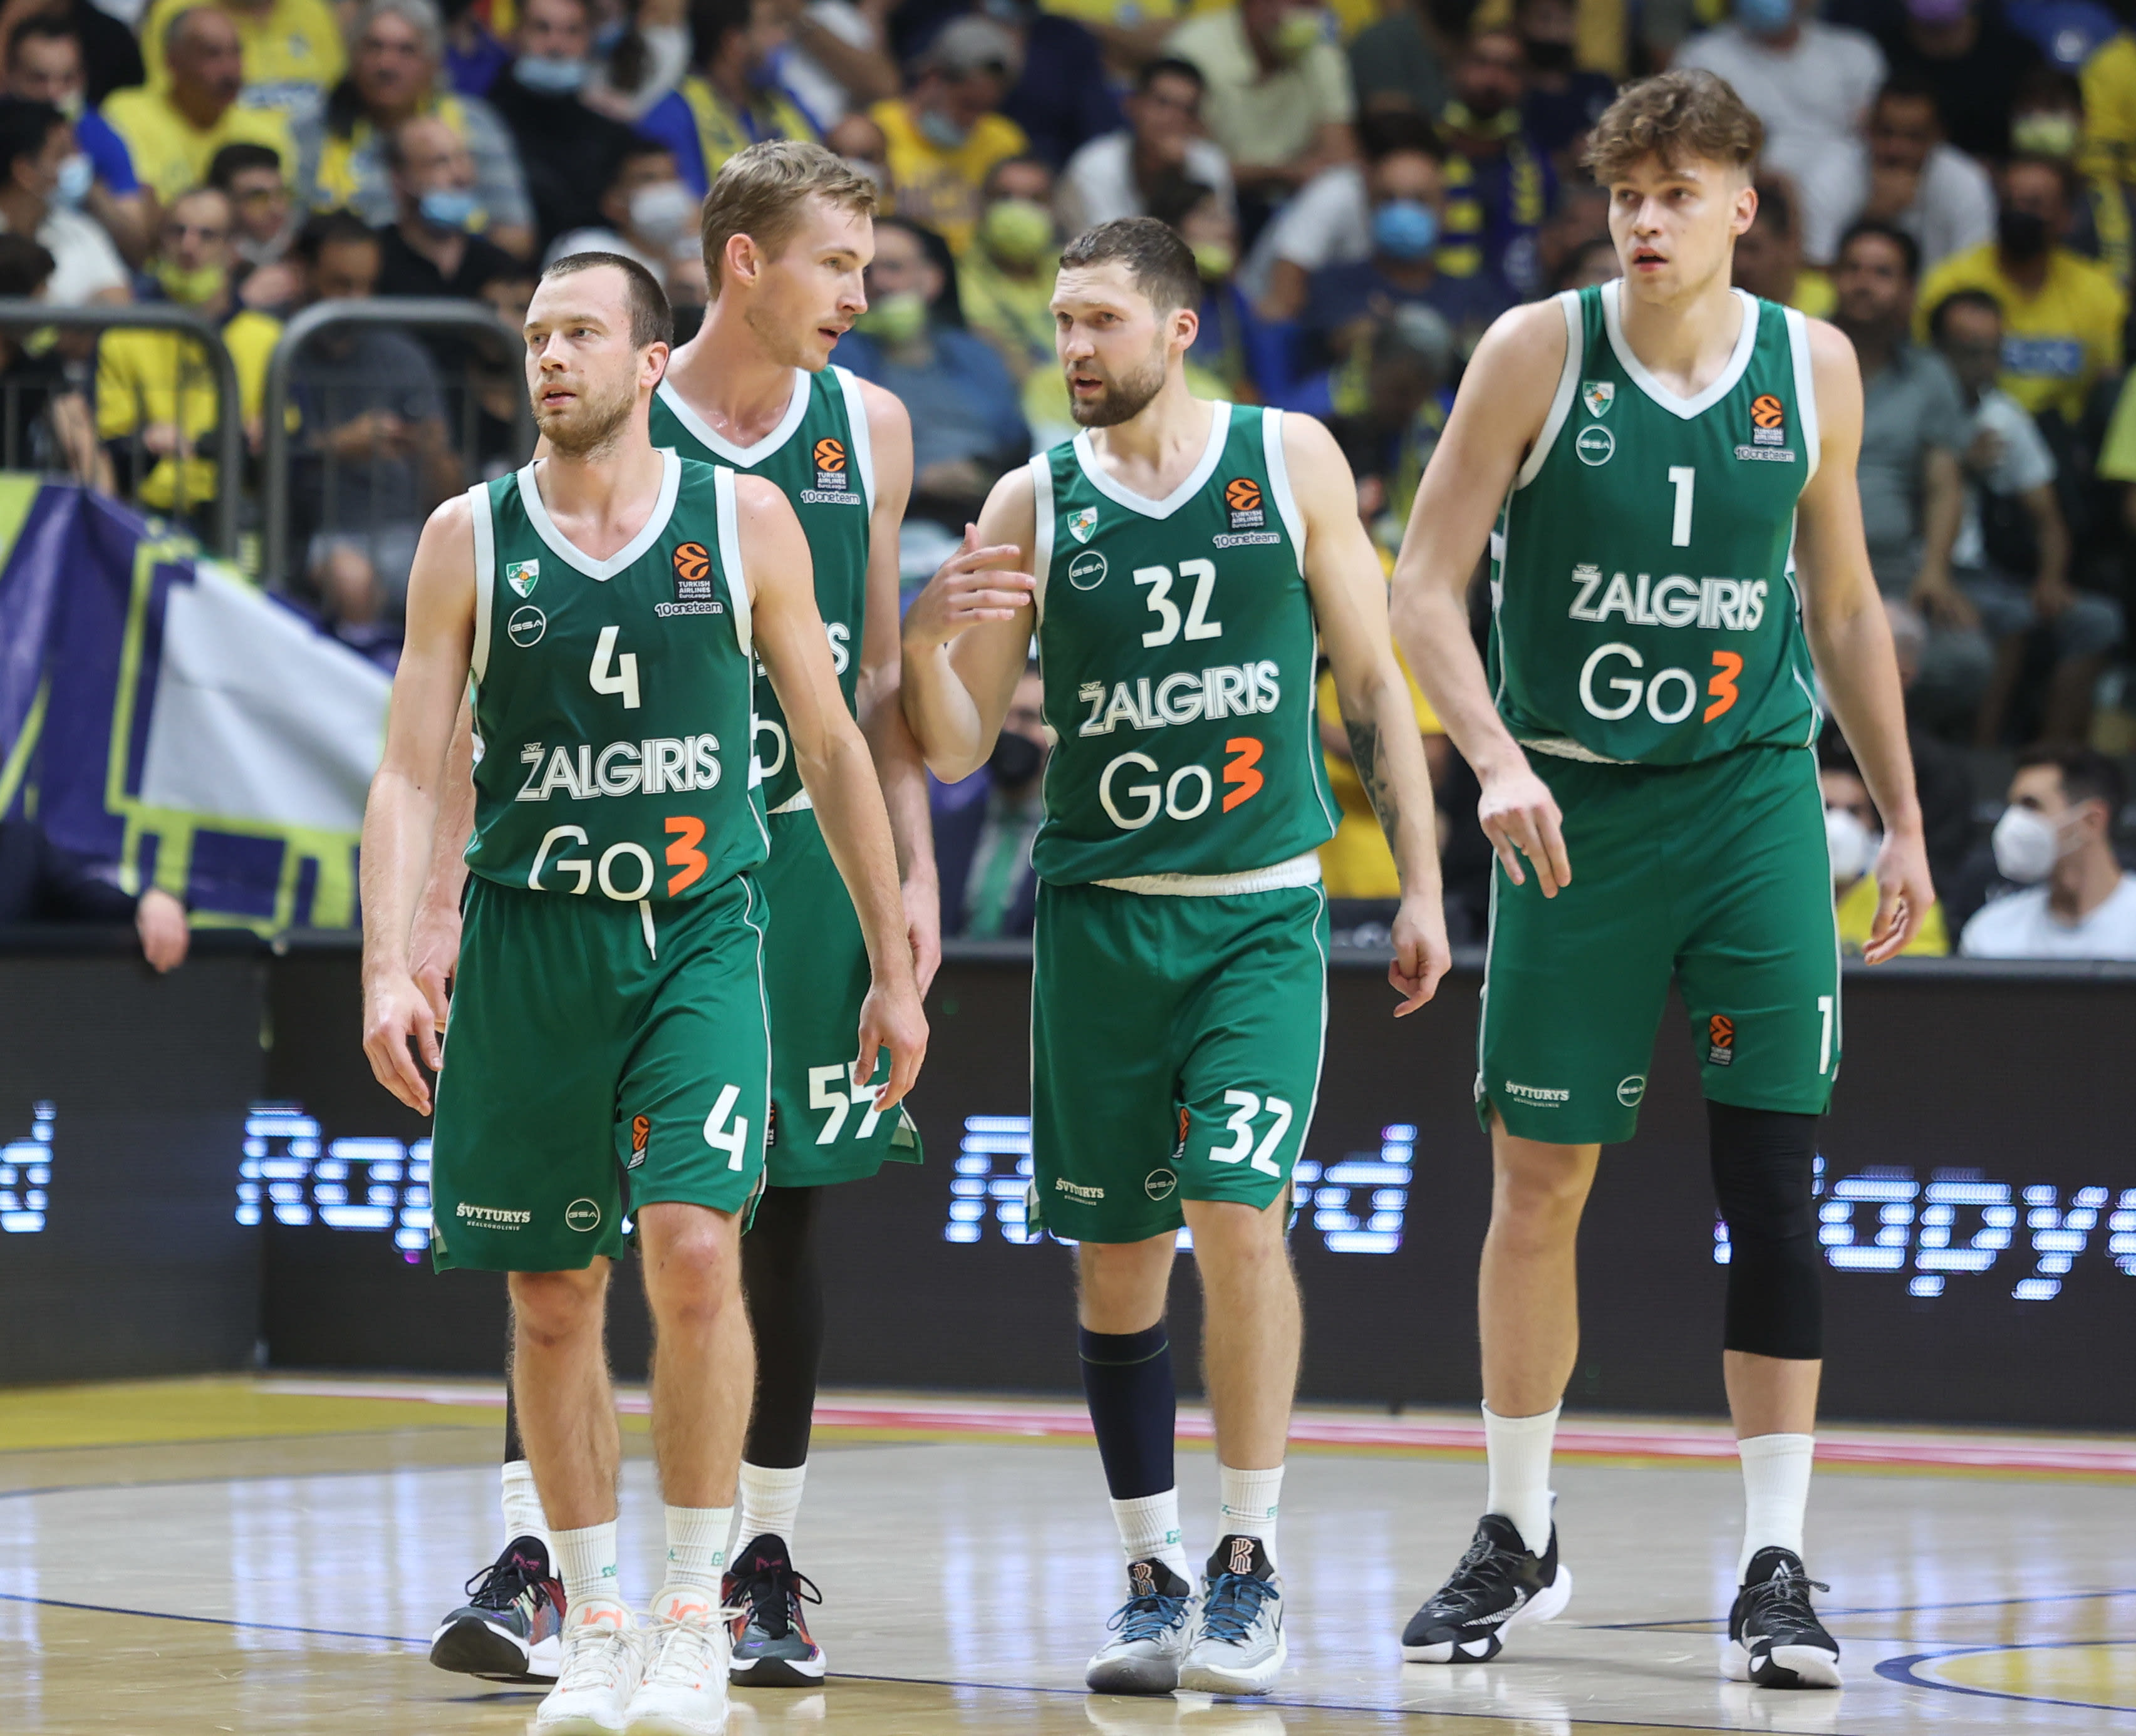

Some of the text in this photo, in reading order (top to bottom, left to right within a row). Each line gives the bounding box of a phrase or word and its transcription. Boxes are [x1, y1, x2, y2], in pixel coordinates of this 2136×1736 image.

[1667, 465, 1695, 547] 1
[511, 619, 542, 633] GSA
[1133, 558, 1221, 648] 32
[1568, 563, 1768, 631] ŽALGIRIS
[589, 626, 641, 709] 4
[1078, 659, 1280, 738] ŽALGIRIS
[514, 734, 721, 802] ŽALGIRIS
[1818, 995, 1833, 1074] 1
[702, 1083, 749, 1172] 4
[1208, 1089, 1293, 1177] 32
[456, 1203, 531, 1223] ŠVYTURYS
